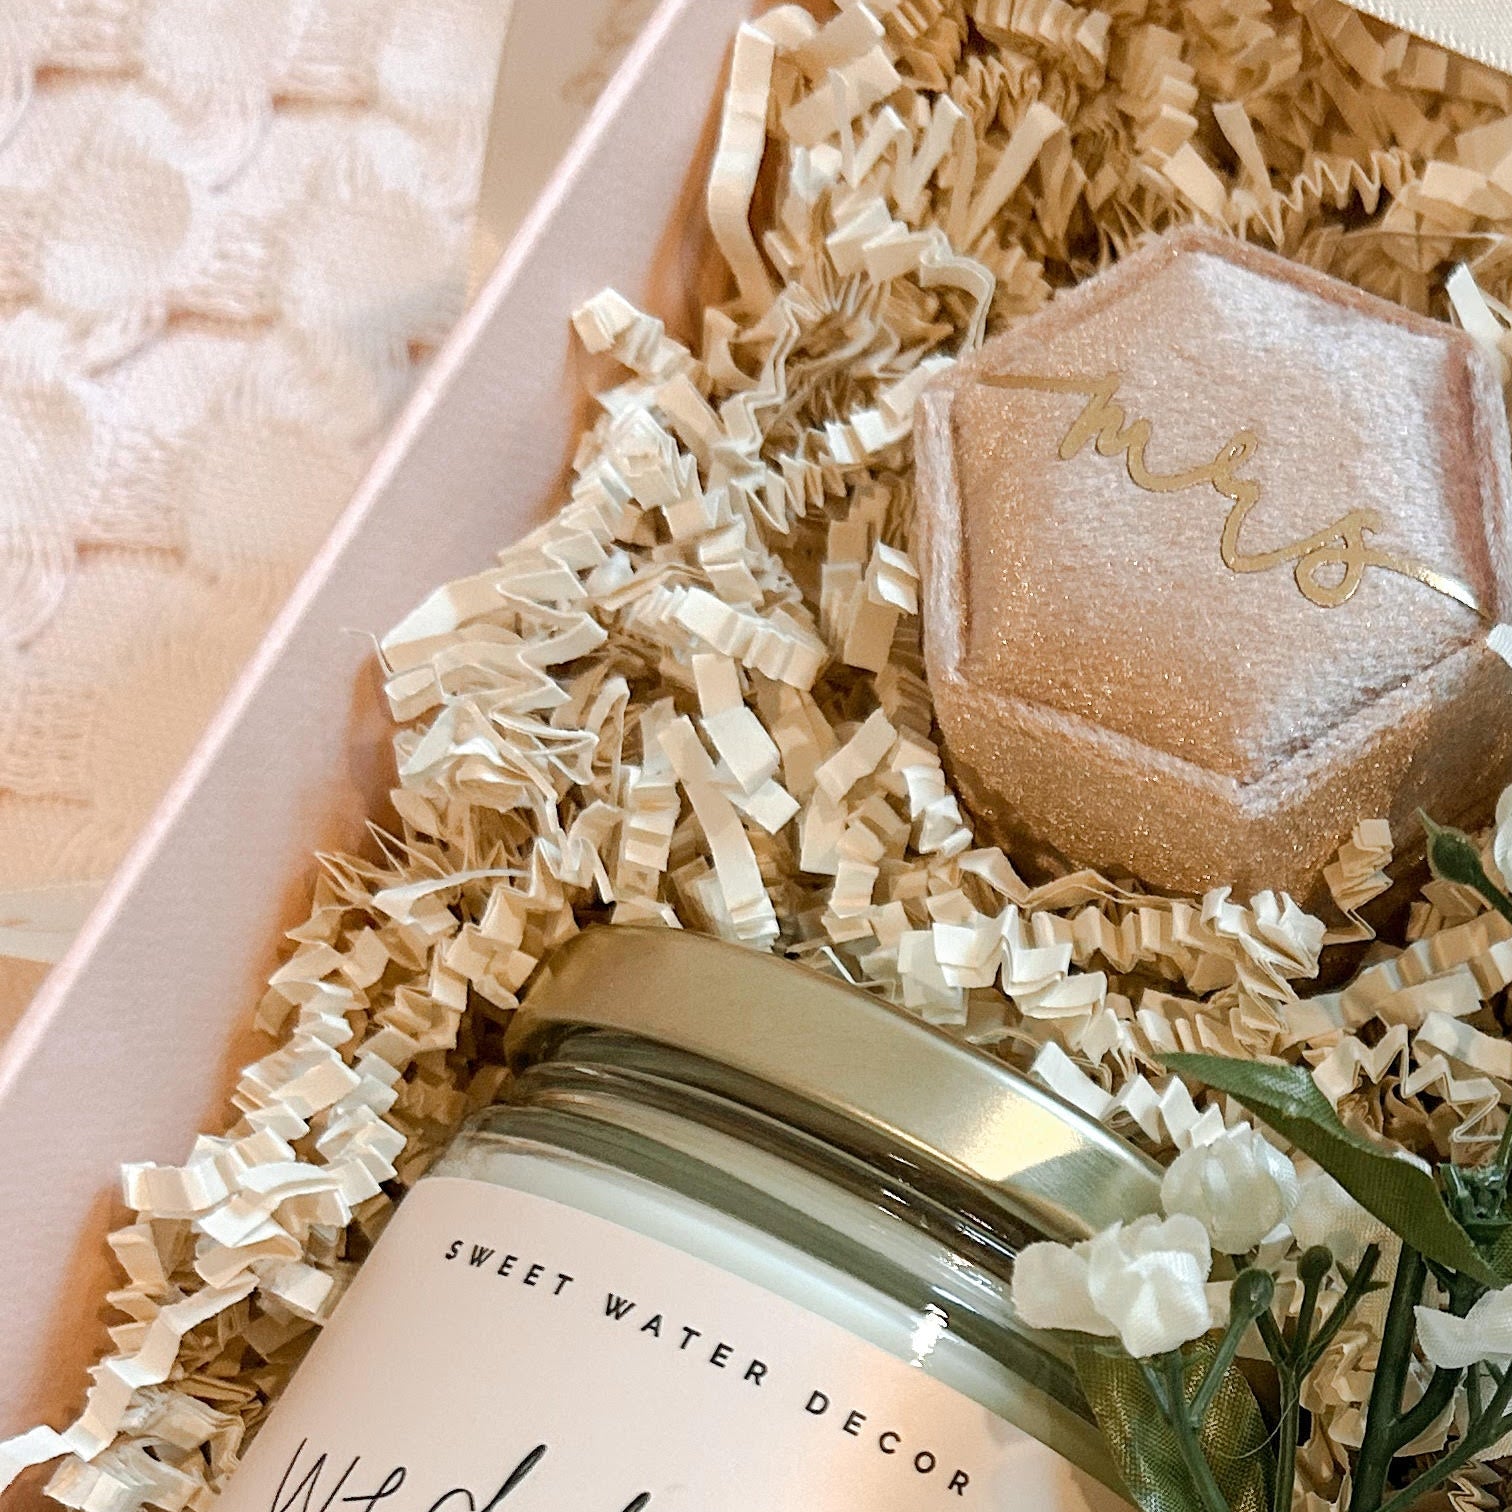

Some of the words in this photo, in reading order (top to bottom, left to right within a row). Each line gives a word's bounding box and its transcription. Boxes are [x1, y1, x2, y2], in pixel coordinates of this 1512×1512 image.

[976, 373, 1490, 617] mrs
[444, 1239, 574, 1296] SWEET
[605, 1293, 769, 1386] WATER
[804, 1389, 971, 1497] DECOR
